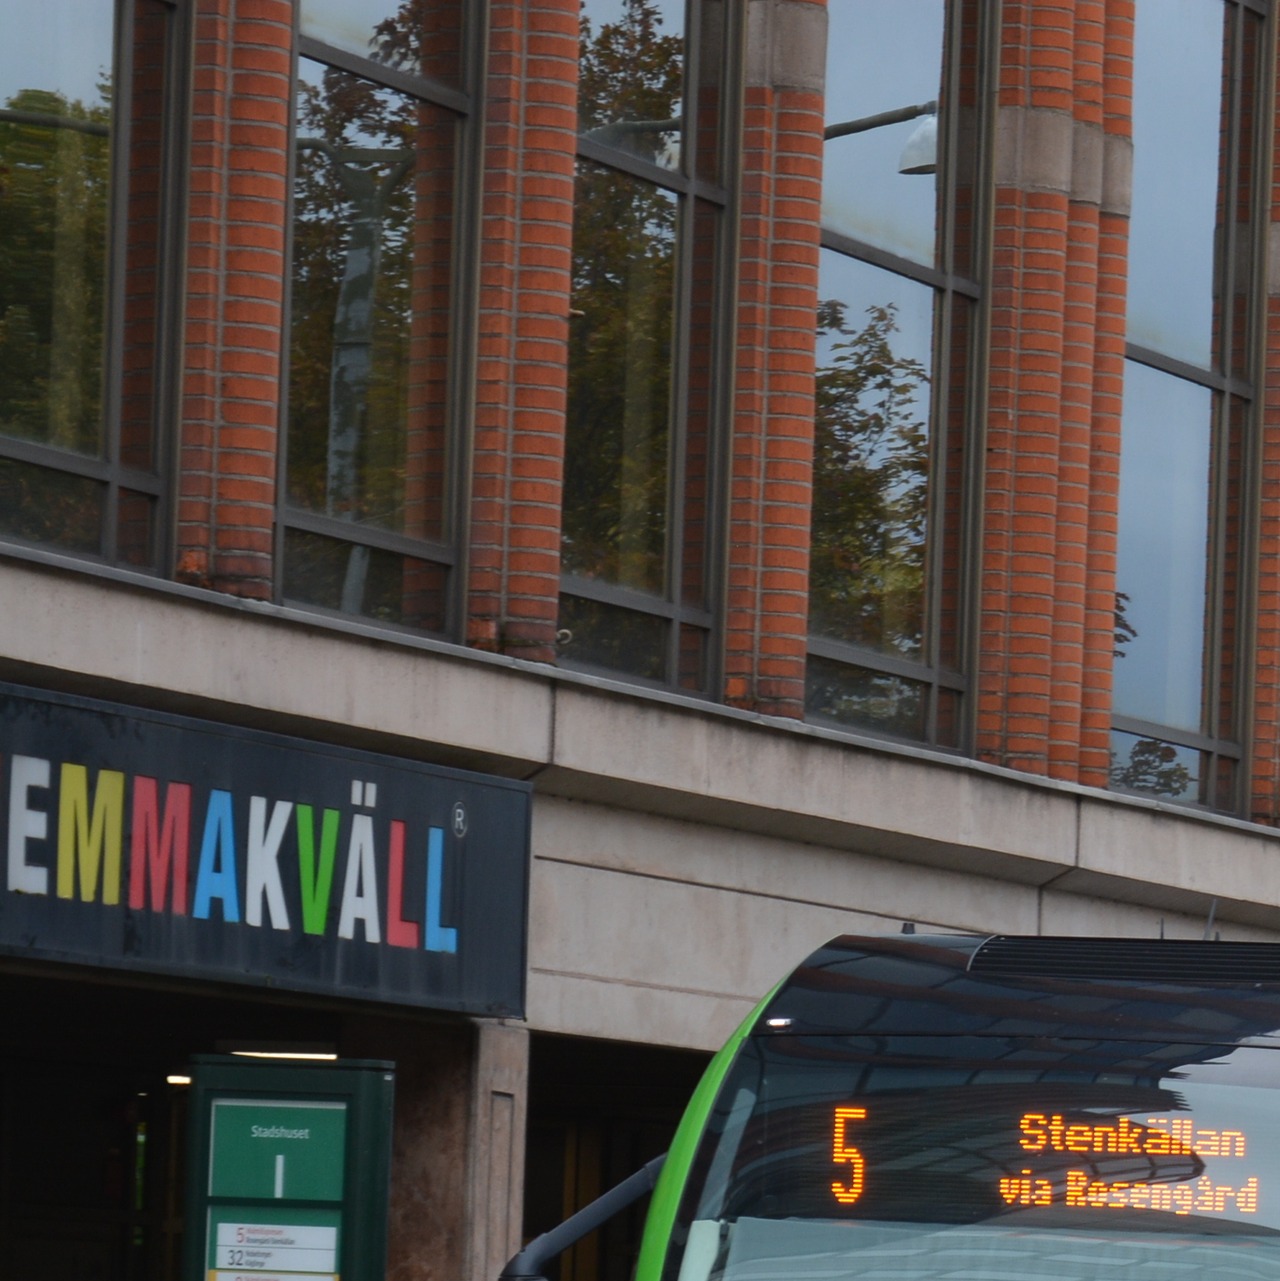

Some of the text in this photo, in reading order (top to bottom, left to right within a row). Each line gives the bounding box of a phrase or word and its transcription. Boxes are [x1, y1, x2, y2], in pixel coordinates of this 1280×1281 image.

[0, 754, 458, 954] EMMAKVÄLL
[250, 1124, 311, 1140] Stadshuset
[1019, 1113, 1246, 1157] Stenkällan
[830, 1107, 866, 1203] 5
[999, 1168, 1259, 1215] via Rosengård
[235, 1227, 246, 1244] 5
[227, 1249, 244, 1267] 32
